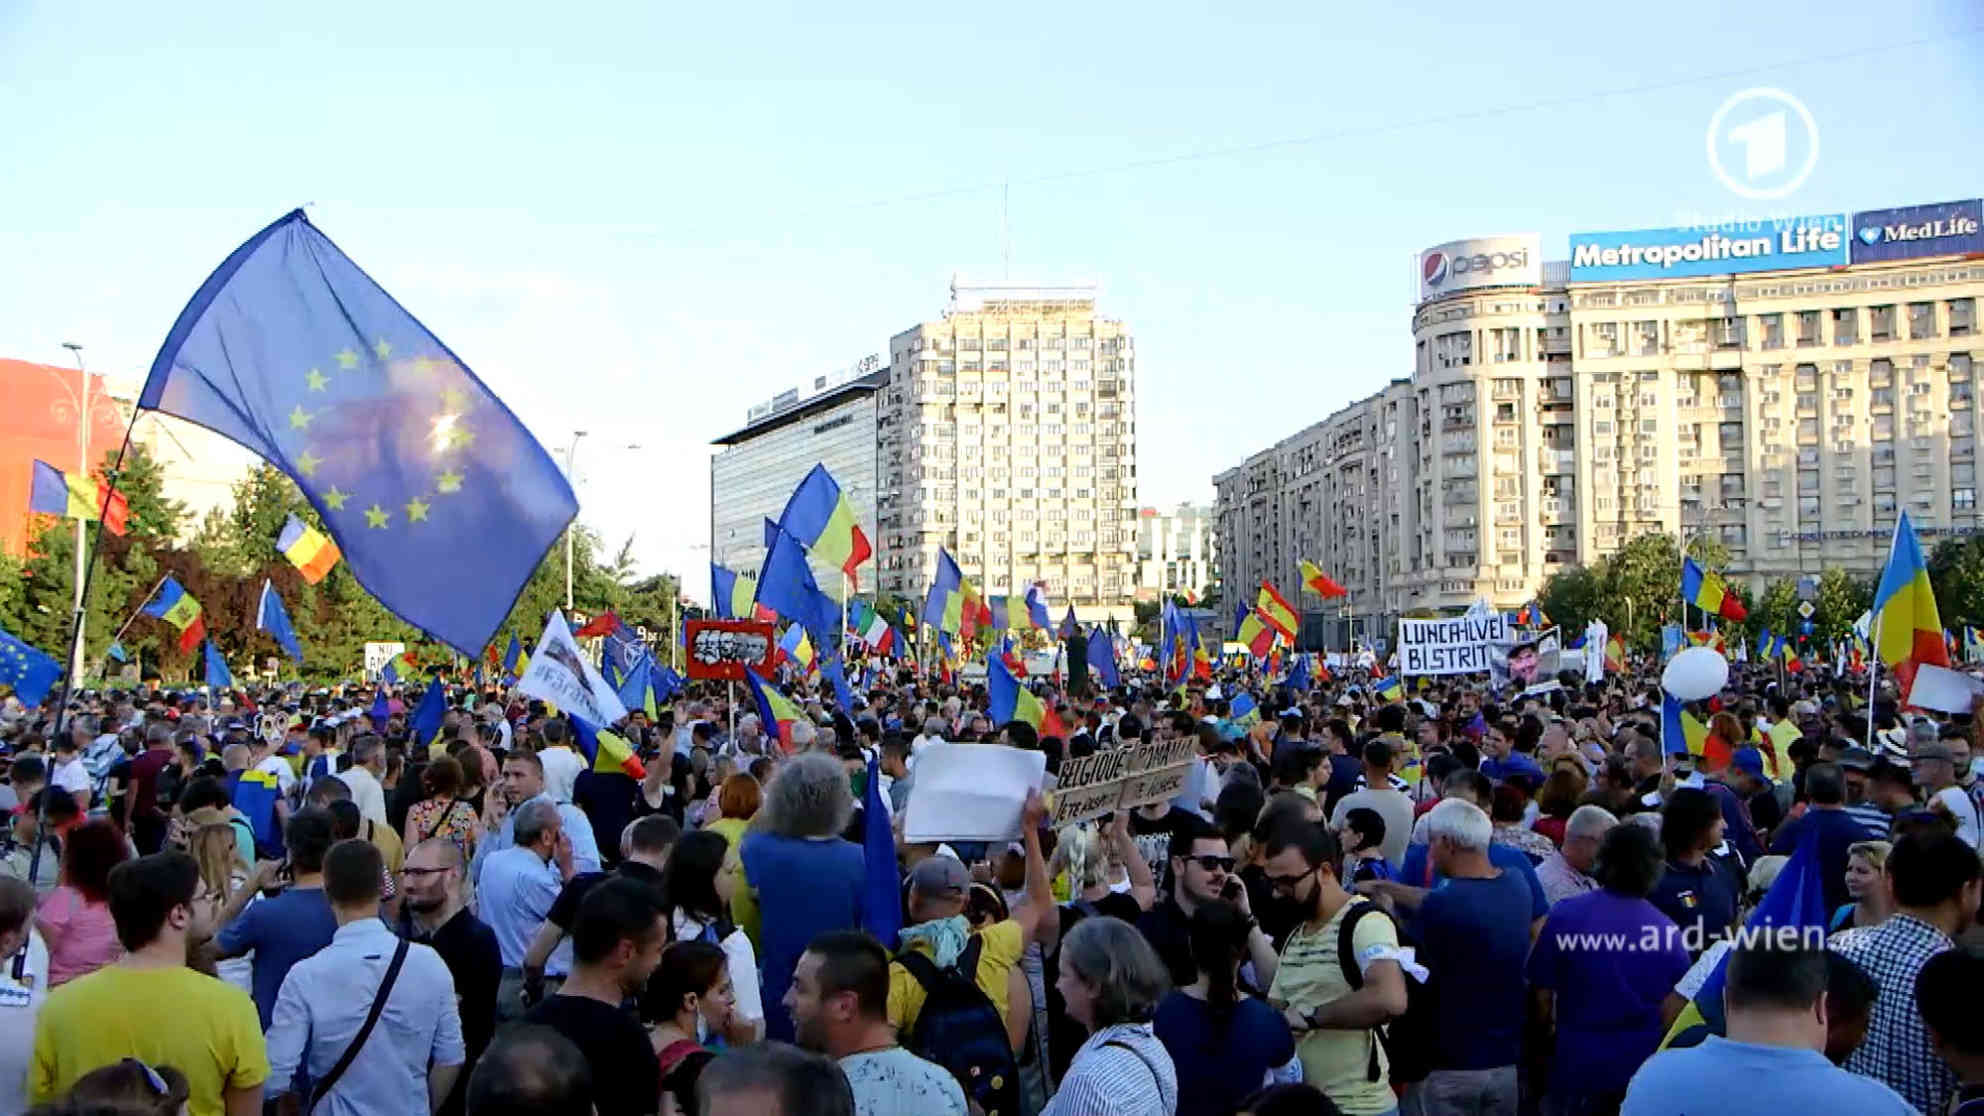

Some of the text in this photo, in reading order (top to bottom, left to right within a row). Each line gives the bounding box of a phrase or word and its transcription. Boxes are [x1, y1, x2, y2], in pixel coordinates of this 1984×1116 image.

[1884, 213, 1978, 243] MedLife
[1451, 247, 1528, 279] pepsi
[1573, 226, 1841, 269] Metropolitan Life
[1407, 643, 1488, 671] BISTRIT
